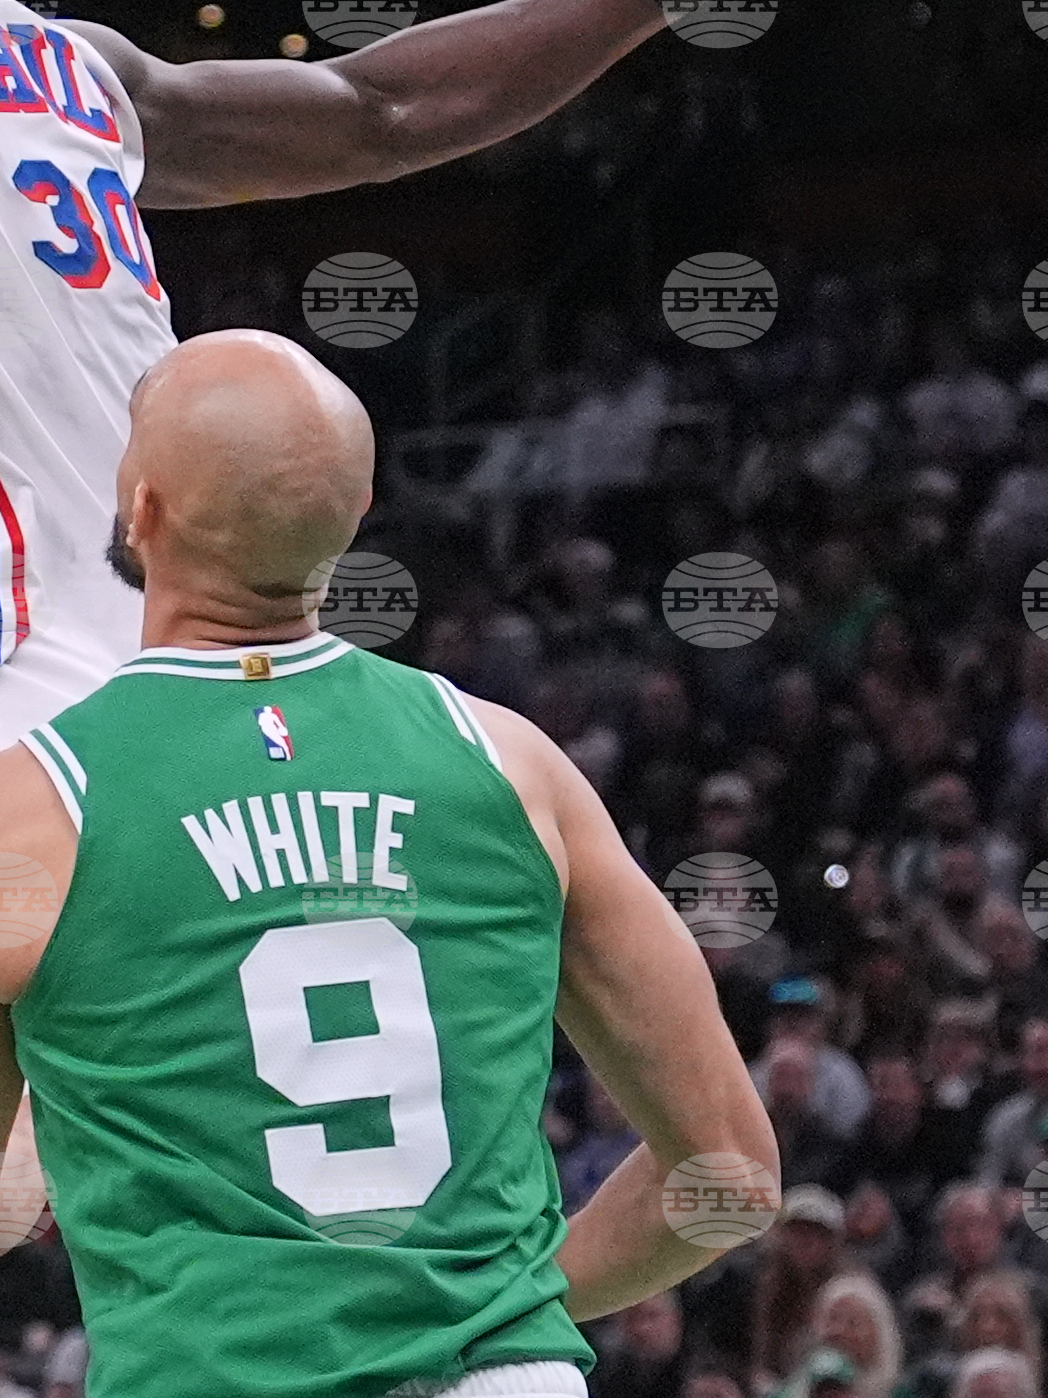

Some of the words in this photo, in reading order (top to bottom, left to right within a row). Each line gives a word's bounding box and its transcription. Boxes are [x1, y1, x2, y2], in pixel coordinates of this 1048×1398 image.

[12, 159, 161, 302] 30
[181, 791, 415, 902] WHITE
[239, 917, 452, 1217] 9
